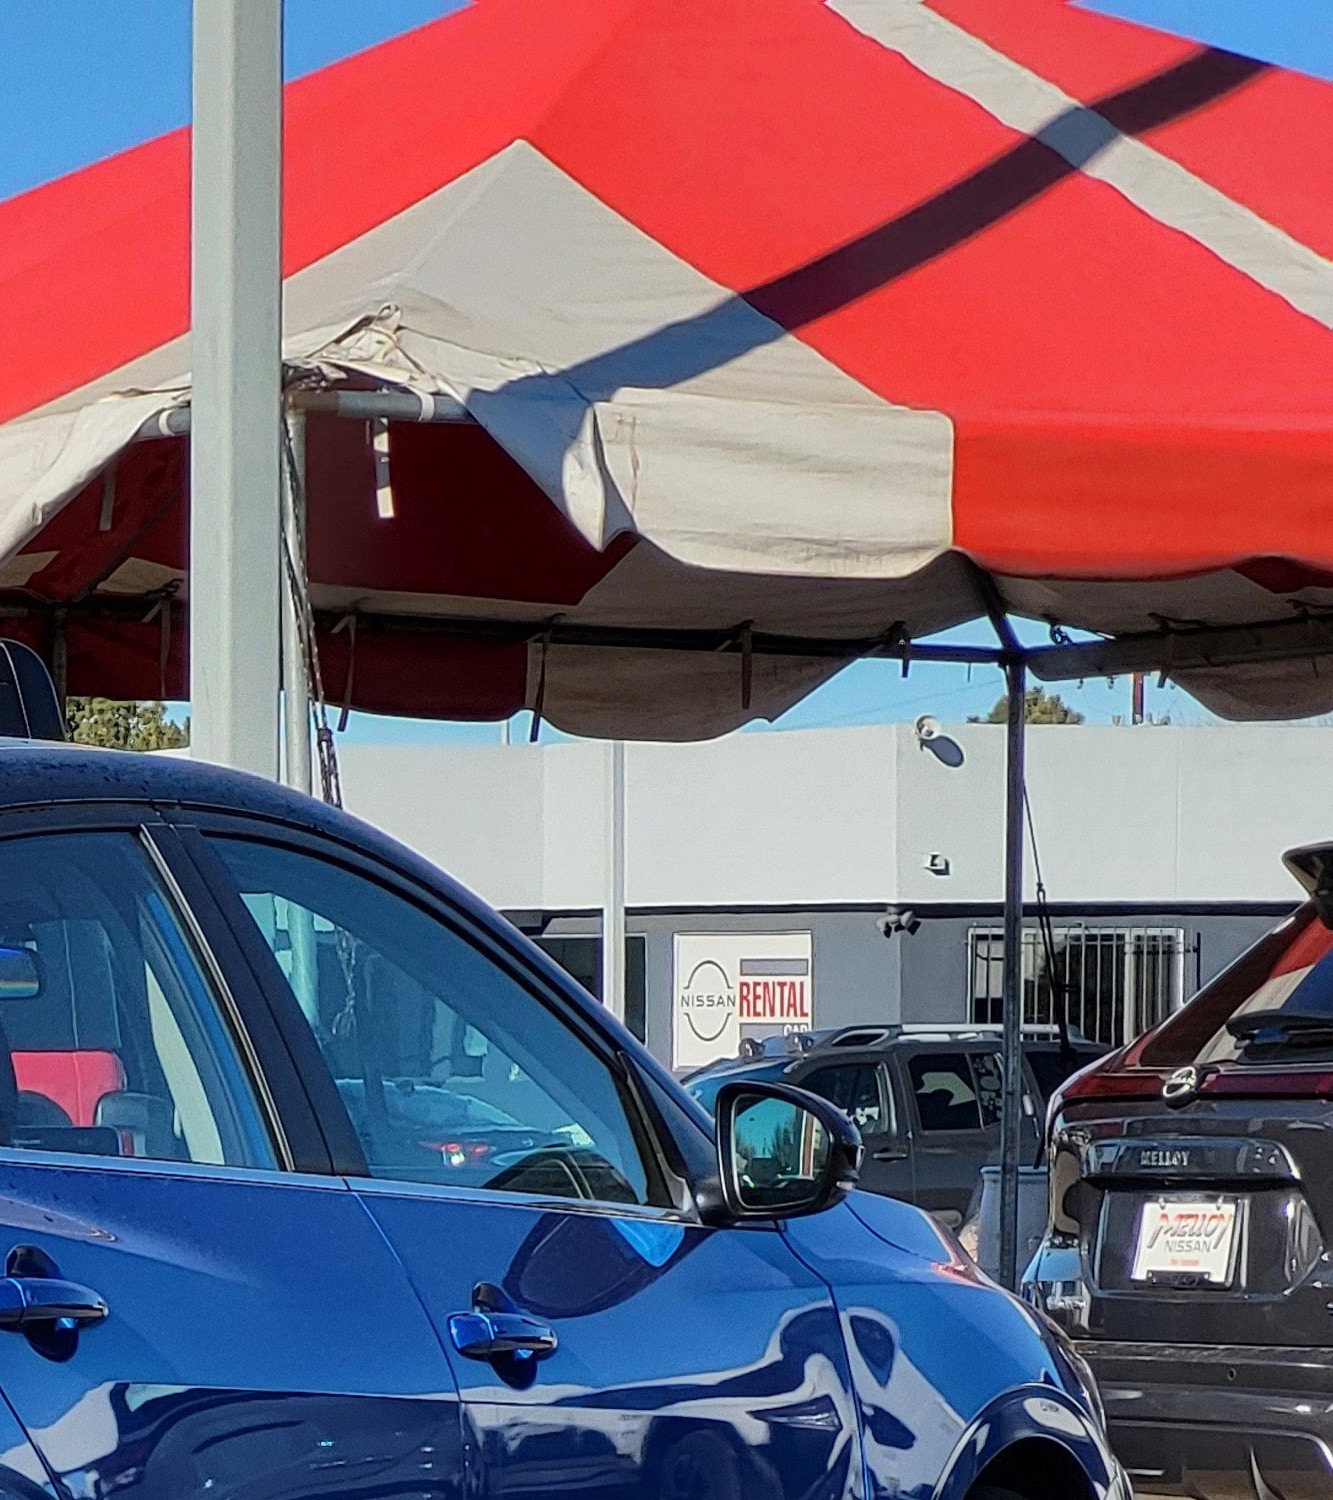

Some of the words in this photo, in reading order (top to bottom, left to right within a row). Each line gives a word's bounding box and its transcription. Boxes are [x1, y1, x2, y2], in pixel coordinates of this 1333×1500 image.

[680, 994, 736, 1008] NISSAN
[738, 980, 809, 1018] RENTAL
[1147, 1213, 1235, 1250] MELLOY
[1164, 1240, 1212, 1253] NISSAN
